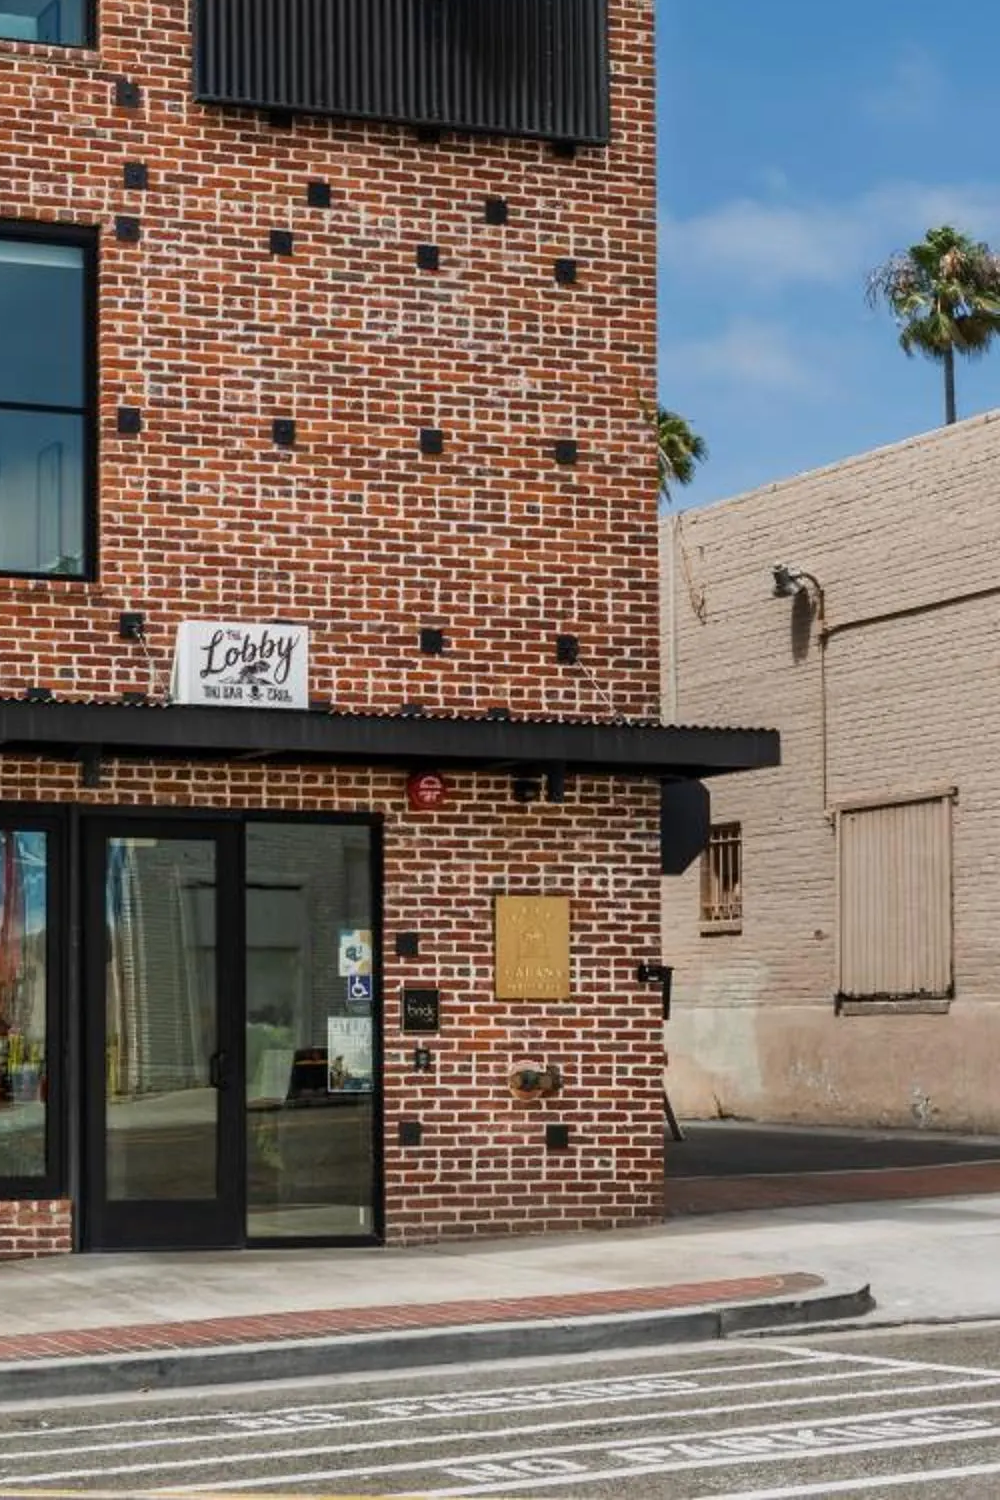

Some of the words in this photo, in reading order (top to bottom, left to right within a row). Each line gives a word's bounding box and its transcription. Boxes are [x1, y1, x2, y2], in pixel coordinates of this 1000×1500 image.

[199, 629, 301, 685] Lobby
[221, 1411, 346, 1430] NO
[440, 1457, 588, 1483] NO
[607, 1415, 993, 1464] PARKING
